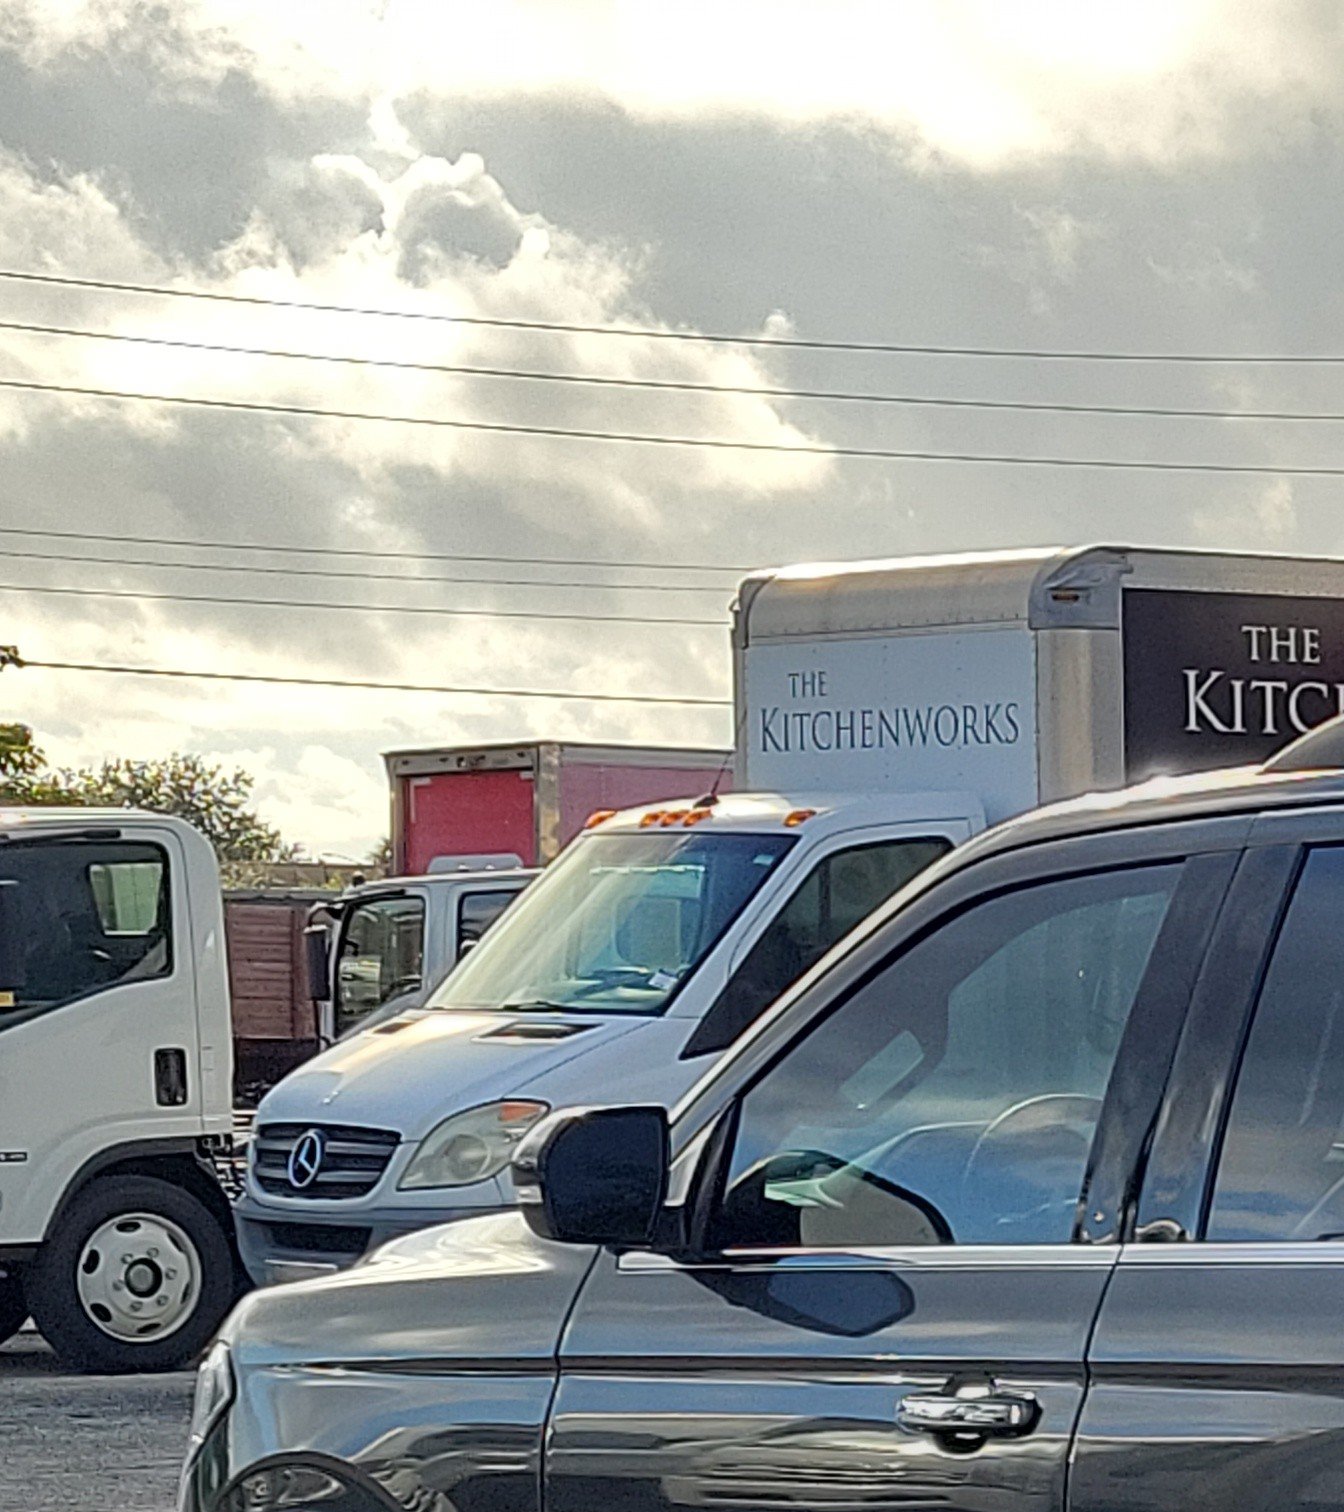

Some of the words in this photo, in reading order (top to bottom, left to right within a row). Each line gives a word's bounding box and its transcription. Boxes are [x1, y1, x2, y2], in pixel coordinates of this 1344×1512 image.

[1241, 625, 1321, 664] THE
[788, 671, 827, 698] THE
[760, 703, 1020, 752] KITCHENWORKS
